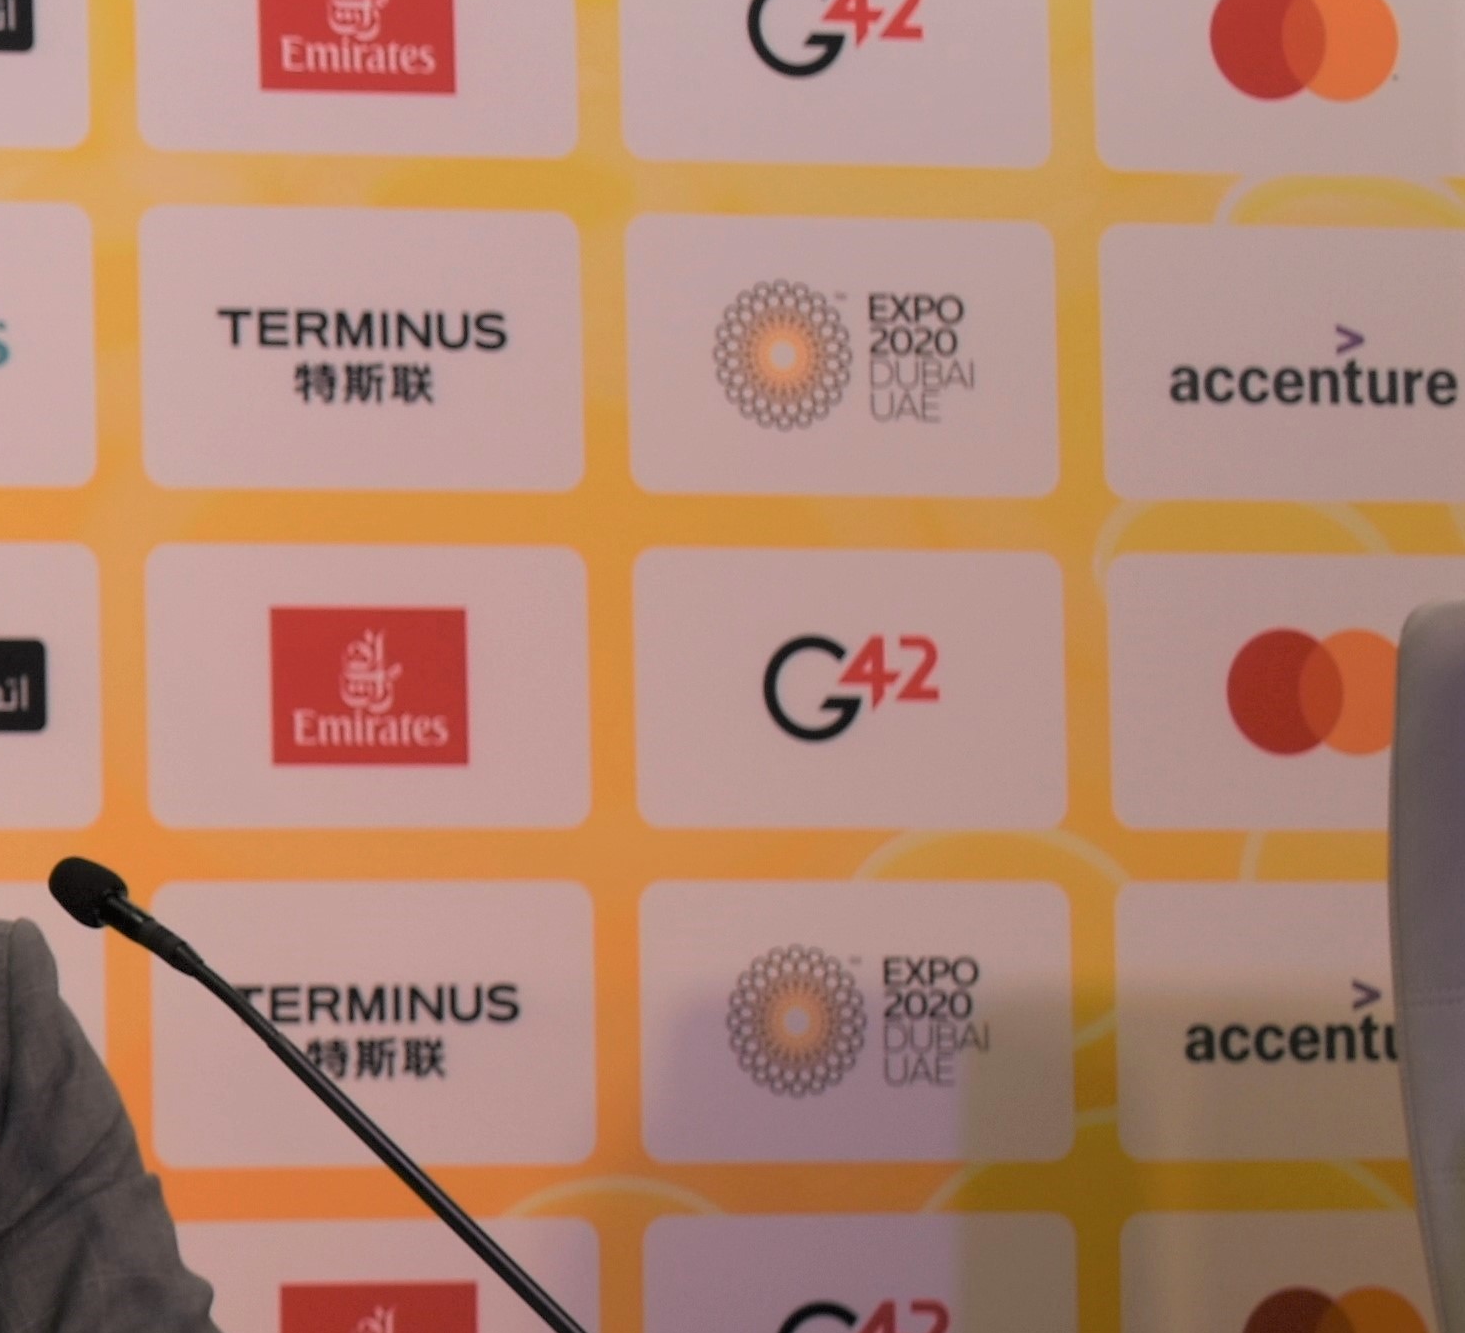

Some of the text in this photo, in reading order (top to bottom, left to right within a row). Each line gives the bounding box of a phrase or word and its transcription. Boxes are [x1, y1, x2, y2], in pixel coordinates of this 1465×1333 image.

[281, 37, 436, 73] Emirates
[869, 295, 964, 324] EXPO
[218, 309, 507, 351] TERMINUS
[870, 328, 958, 355] 2020
[295, 363, 432, 403] 特斯联
[870, 358, 975, 392] DUBAI
[1170, 360, 1457, 406] accenture
[870, 392, 938, 422] UAE
[763, 636, 937, 742] G42
[294, 710, 449, 745] Emirates
[883, 958, 979, 987] EXPO
[884, 988, 972, 1021] 2020
[884, 1021, 990, 1054] DUBAI
[1184, 1015, 1398, 1063] accent
[884, 1054, 953, 1085] UAE
